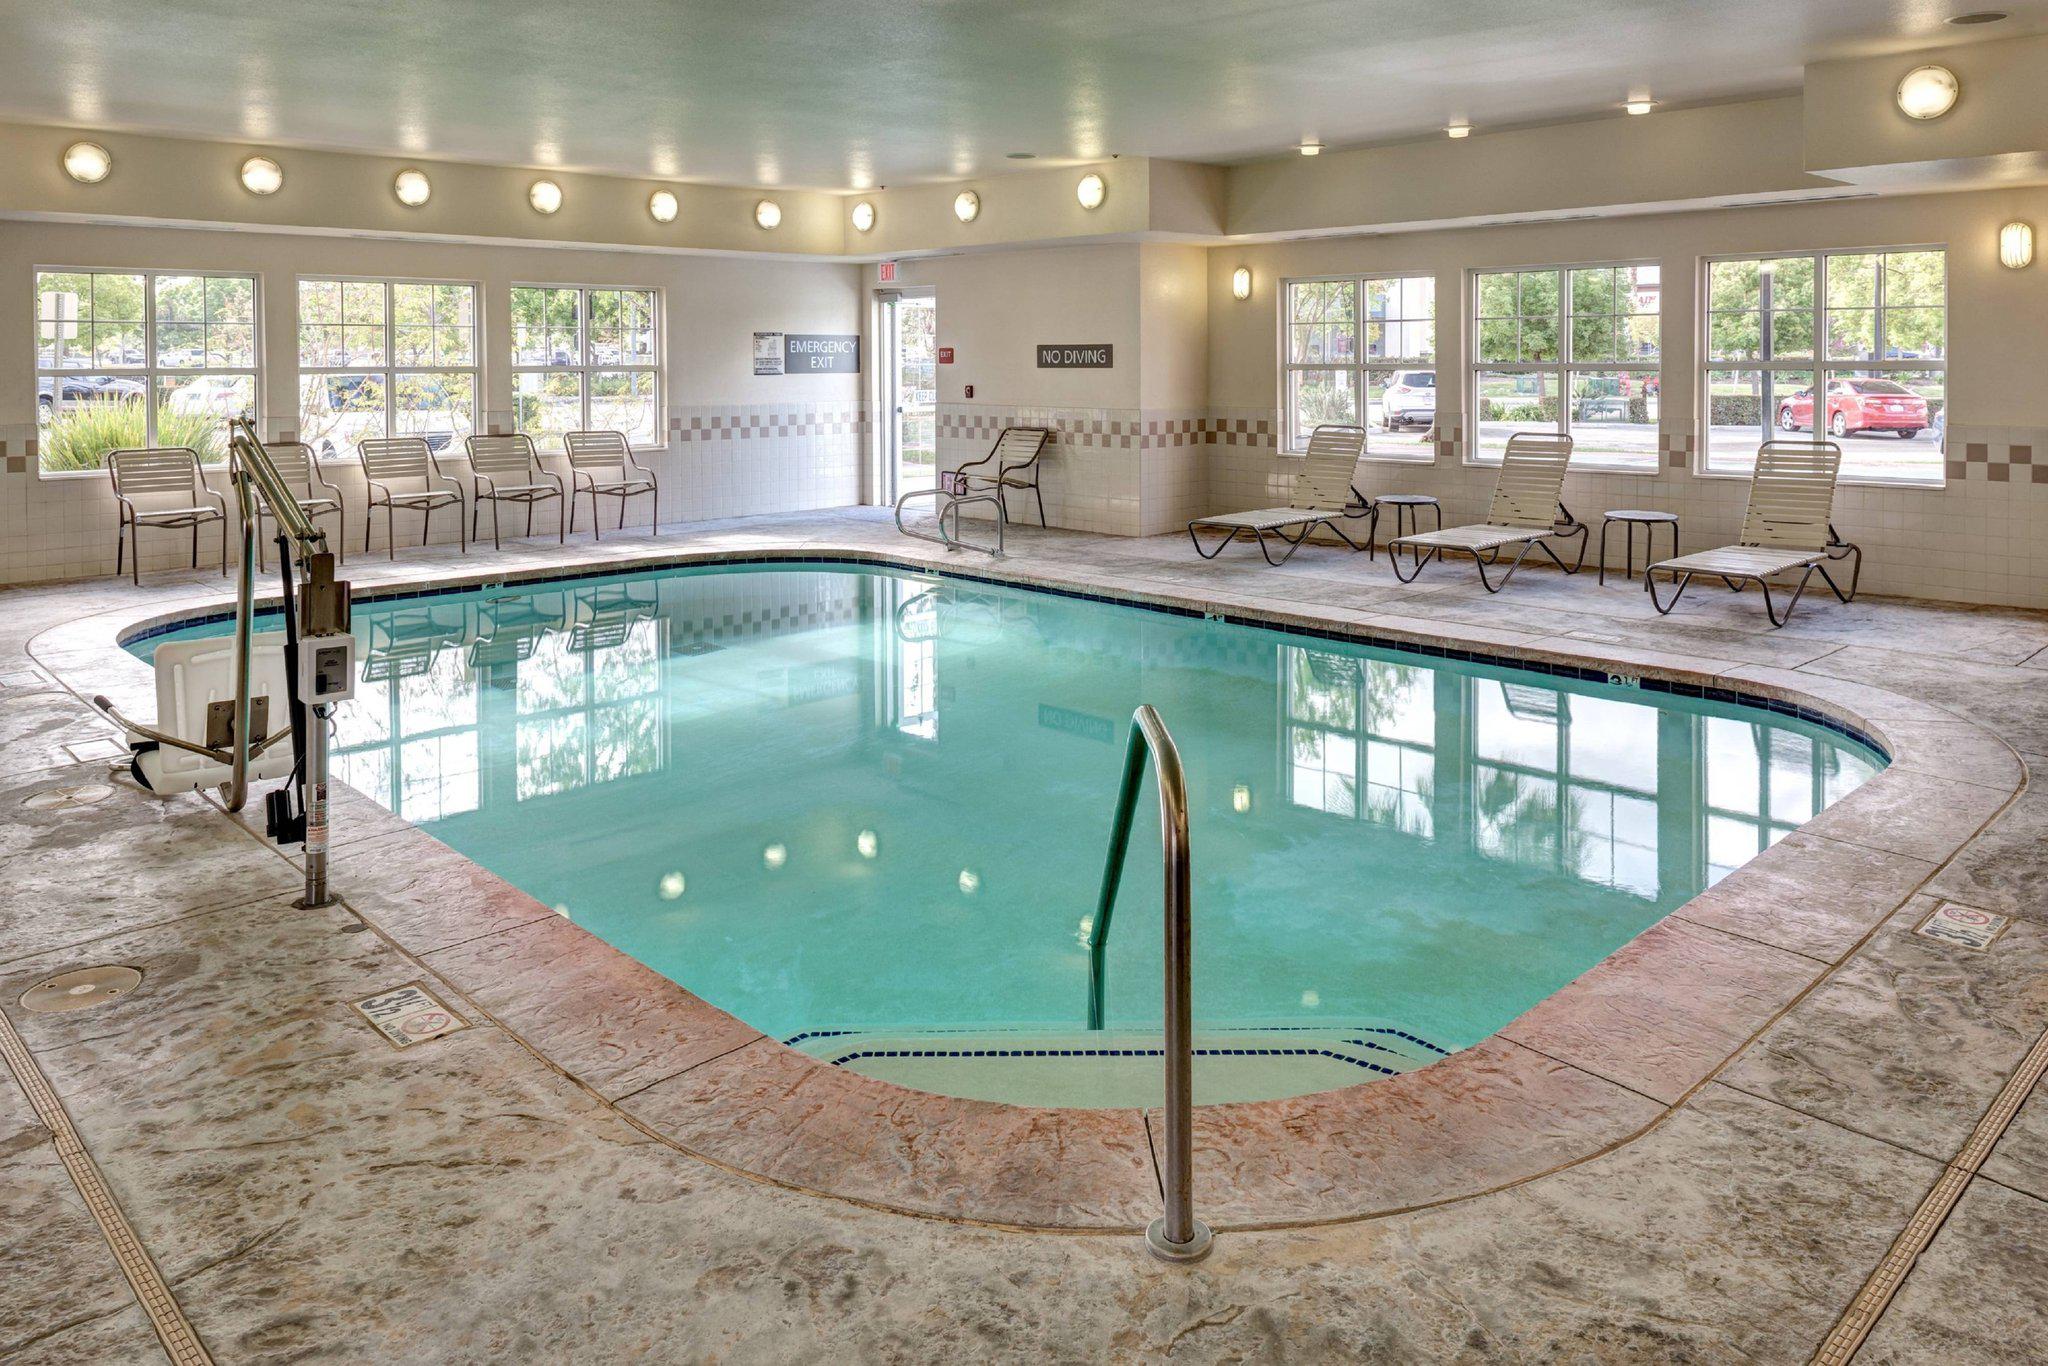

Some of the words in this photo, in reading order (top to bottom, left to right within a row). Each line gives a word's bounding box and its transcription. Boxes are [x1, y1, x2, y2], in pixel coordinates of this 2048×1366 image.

[880, 264, 895, 280] EXIT
[790, 340, 856, 353] EMERGENCY
[810, 356, 834, 368] EXIT
[1042, 350, 1060, 363] NO
[1064, 349, 1106, 363] DIVING
